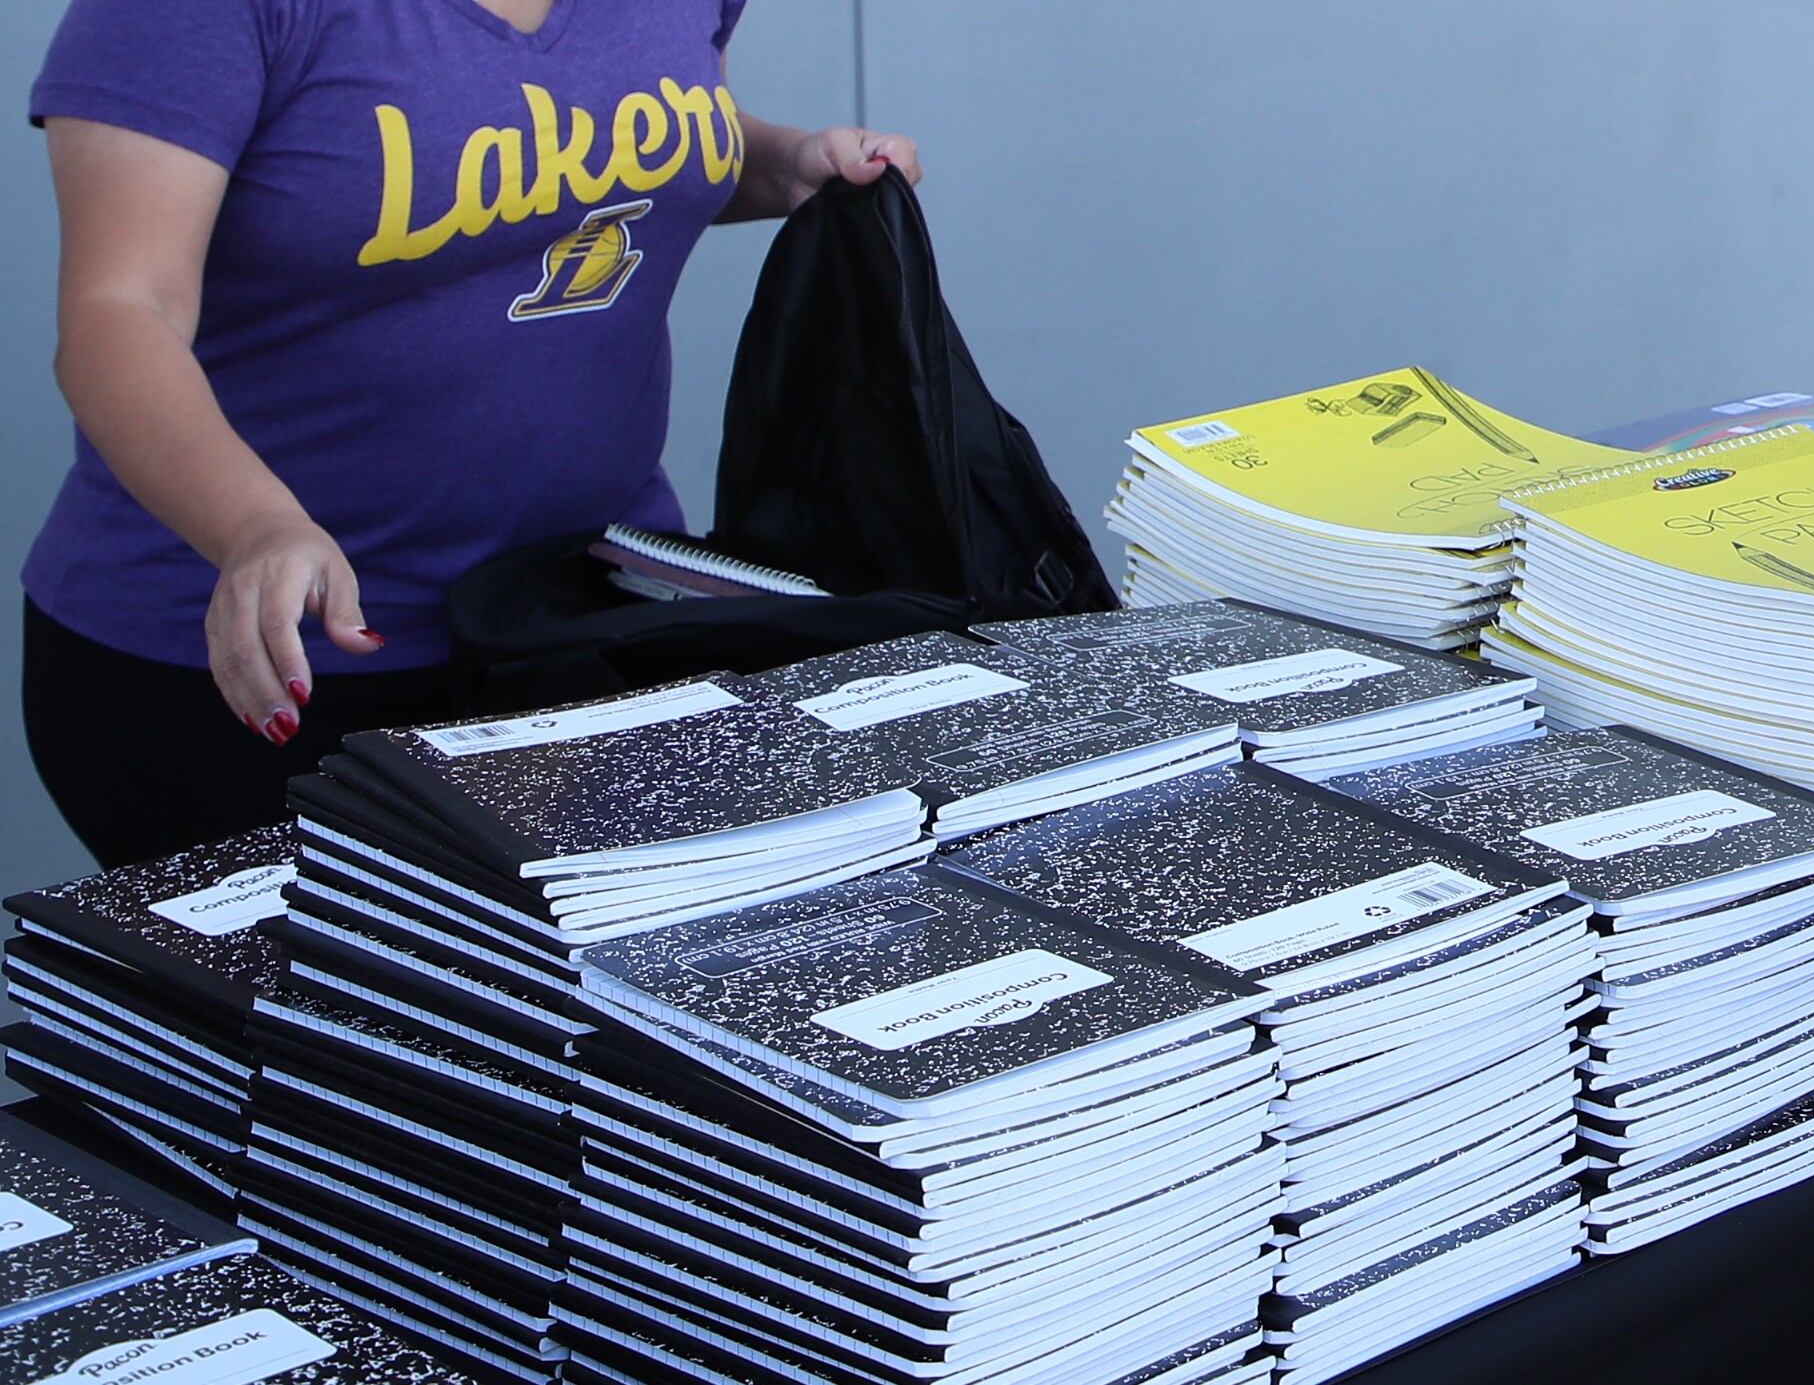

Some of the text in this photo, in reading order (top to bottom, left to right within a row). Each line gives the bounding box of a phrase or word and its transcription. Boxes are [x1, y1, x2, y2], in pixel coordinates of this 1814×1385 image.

[1231, 454, 1268, 470] 30
[813, 673, 975, 714] Composition Book
[1576, 808, 1738, 847] Composition Book
[1657, 825, 1708, 844] Pacon
[189, 878, 298, 913] Compositi
[227, 866, 283, 890] Pacon
[876, 972, 1069, 1034] Composition Book
[974, 998, 1033, 1024] Pacon
[78, 1341, 158, 1378] Pacon
[101, 1329, 268, 1385] osition Book
